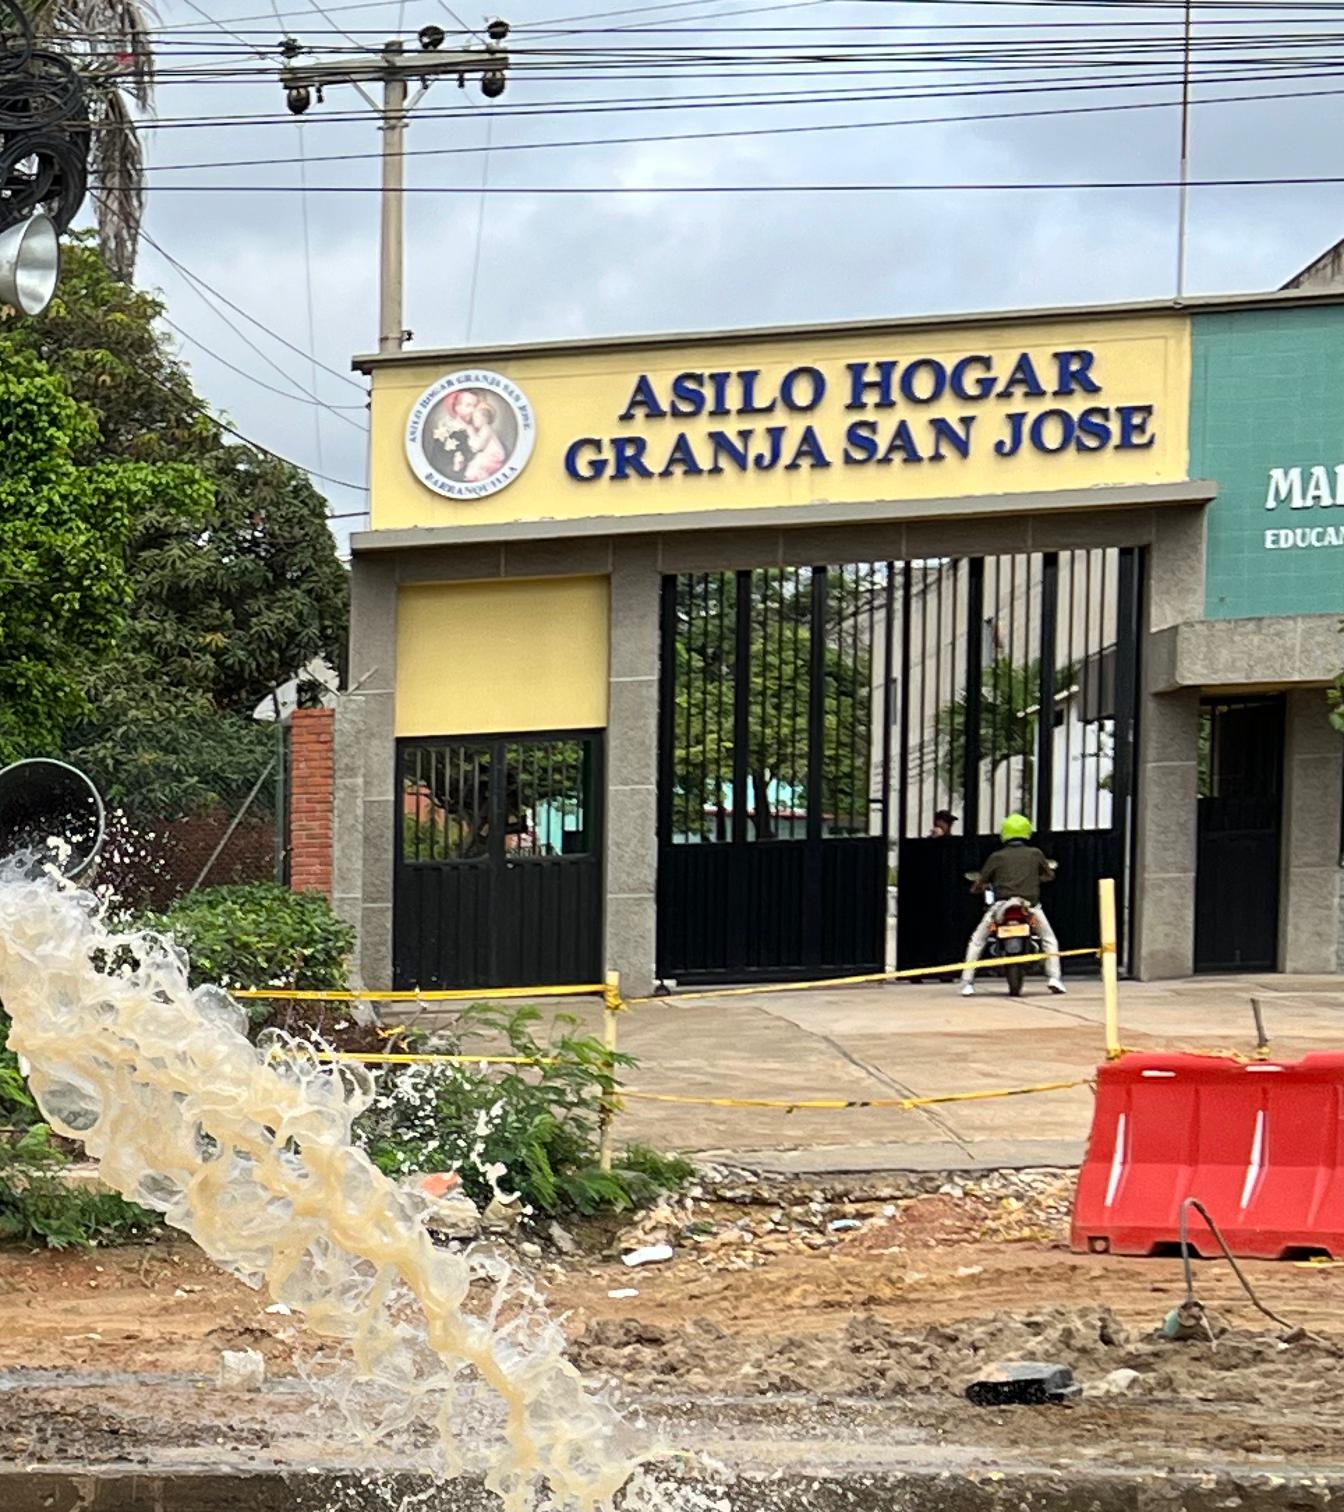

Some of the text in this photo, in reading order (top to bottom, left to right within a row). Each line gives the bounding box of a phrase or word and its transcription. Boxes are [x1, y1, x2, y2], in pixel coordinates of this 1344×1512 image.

[619, 350, 1102, 421] ASILO HOGAR
[564, 404, 1156, 482] GRANJA SAN JOSE
